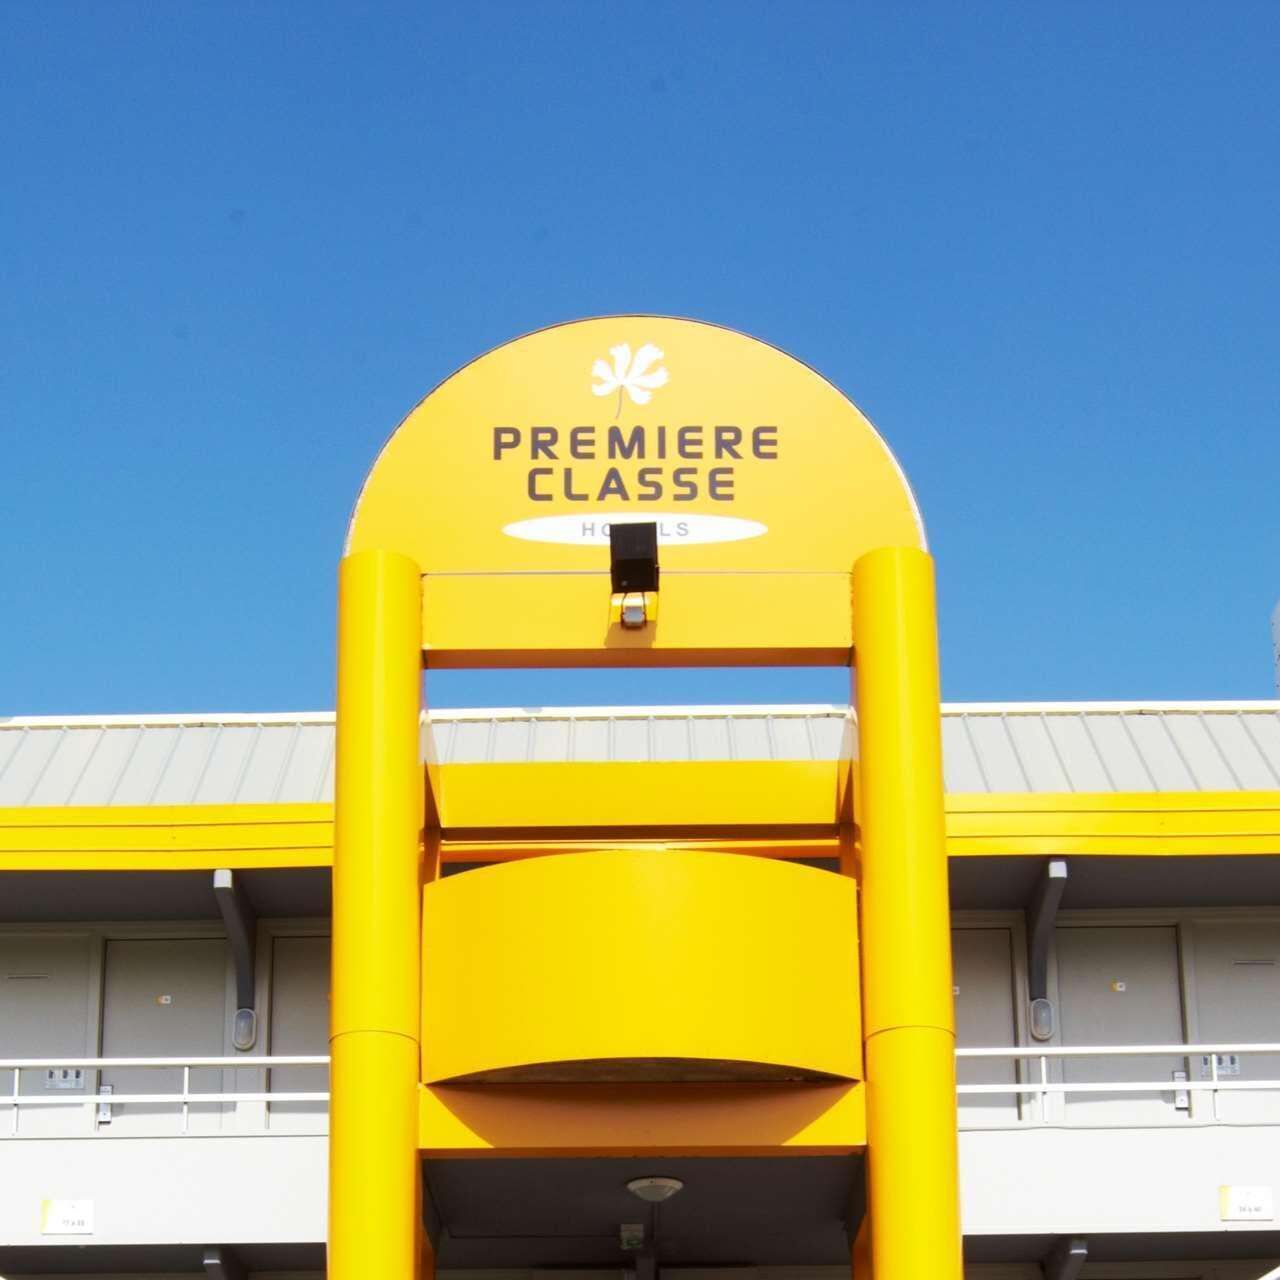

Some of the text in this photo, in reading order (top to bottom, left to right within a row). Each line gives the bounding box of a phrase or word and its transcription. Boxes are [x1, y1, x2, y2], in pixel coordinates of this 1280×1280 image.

[493, 425, 778, 461] PREMIERE
[527, 467, 736, 502] CLASSE
[582, 522, 690, 537] HOLS
